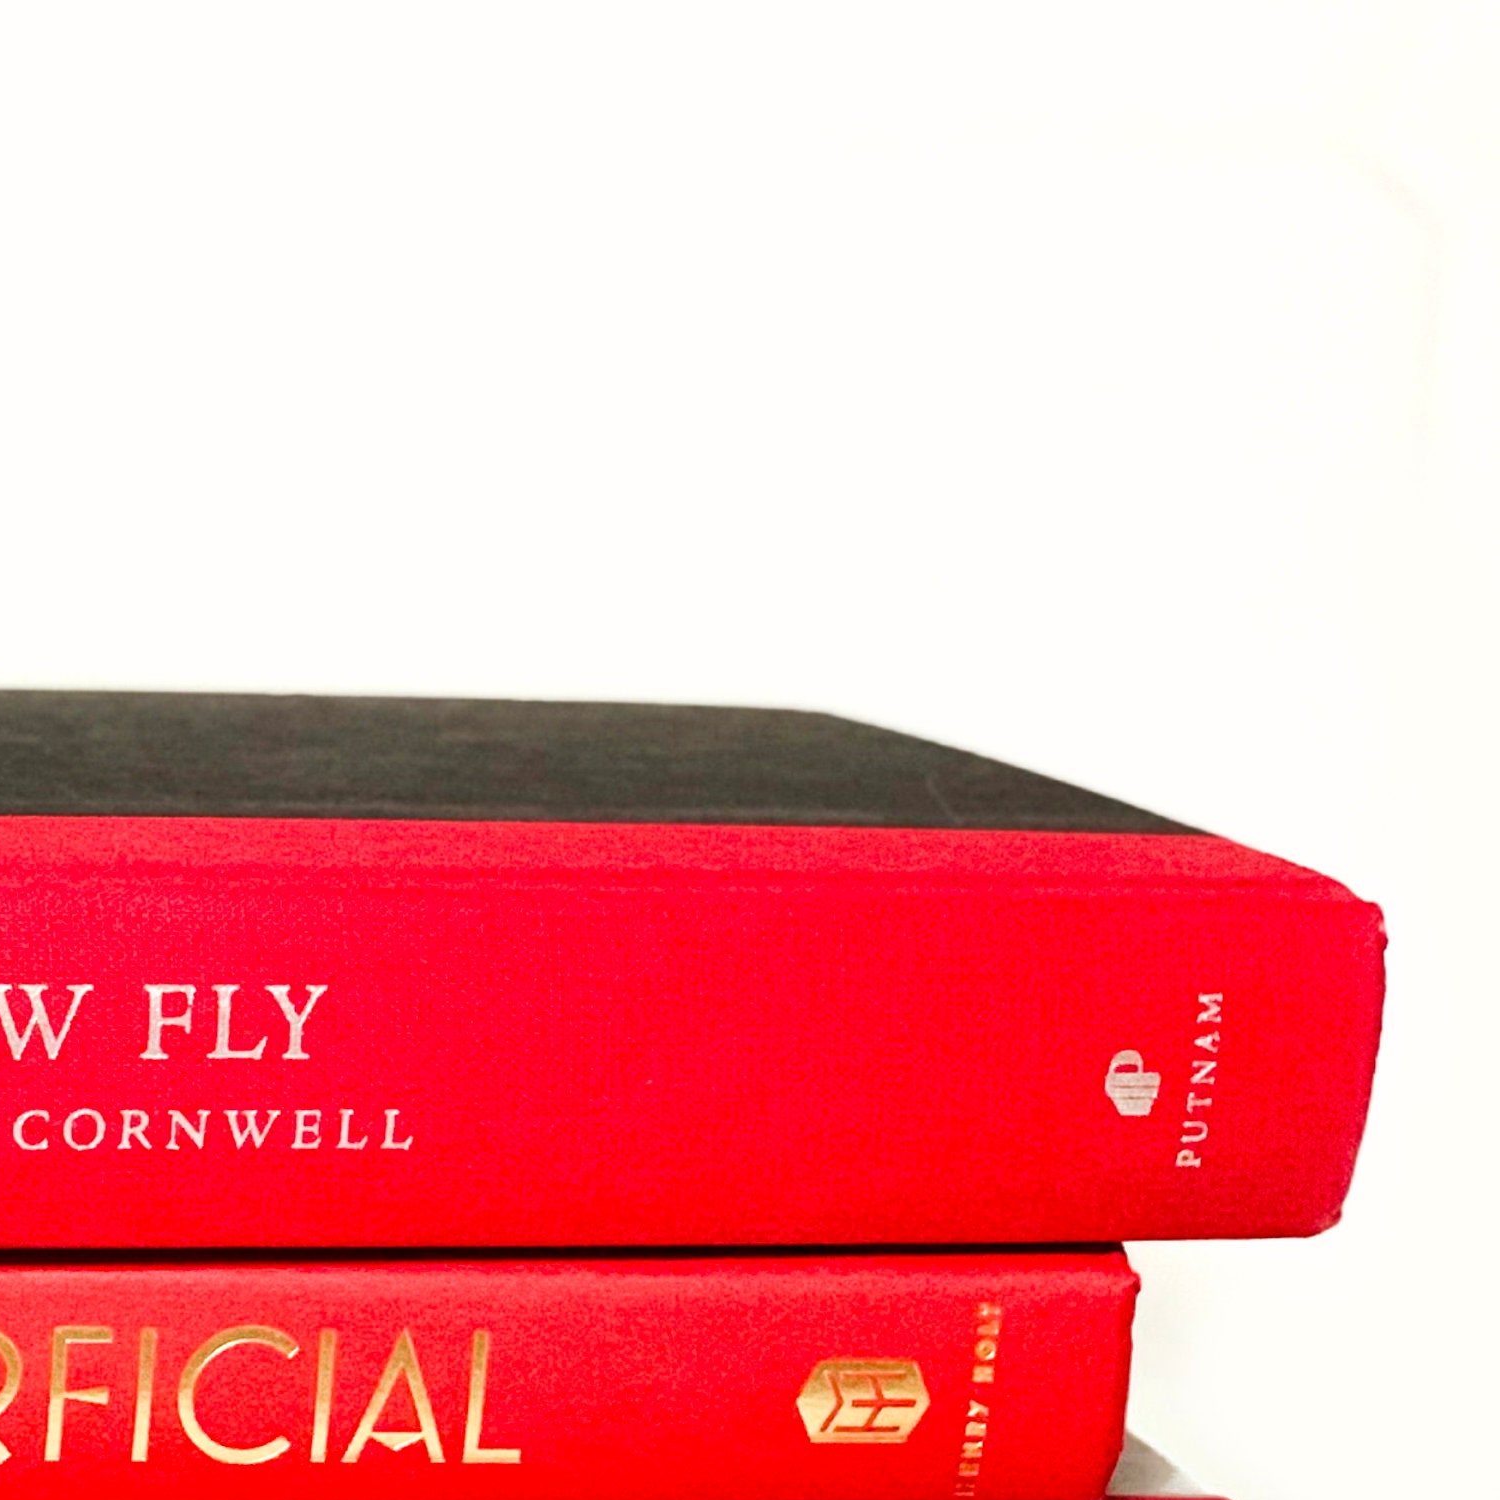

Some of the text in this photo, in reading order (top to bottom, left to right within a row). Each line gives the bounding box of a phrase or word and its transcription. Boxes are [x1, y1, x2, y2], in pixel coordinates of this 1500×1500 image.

[140, 984, 328, 1060] FLY
[1176, 993, 1223, 1167] PUTNAM
[13, 1108, 413, 1151] CORNWELL
